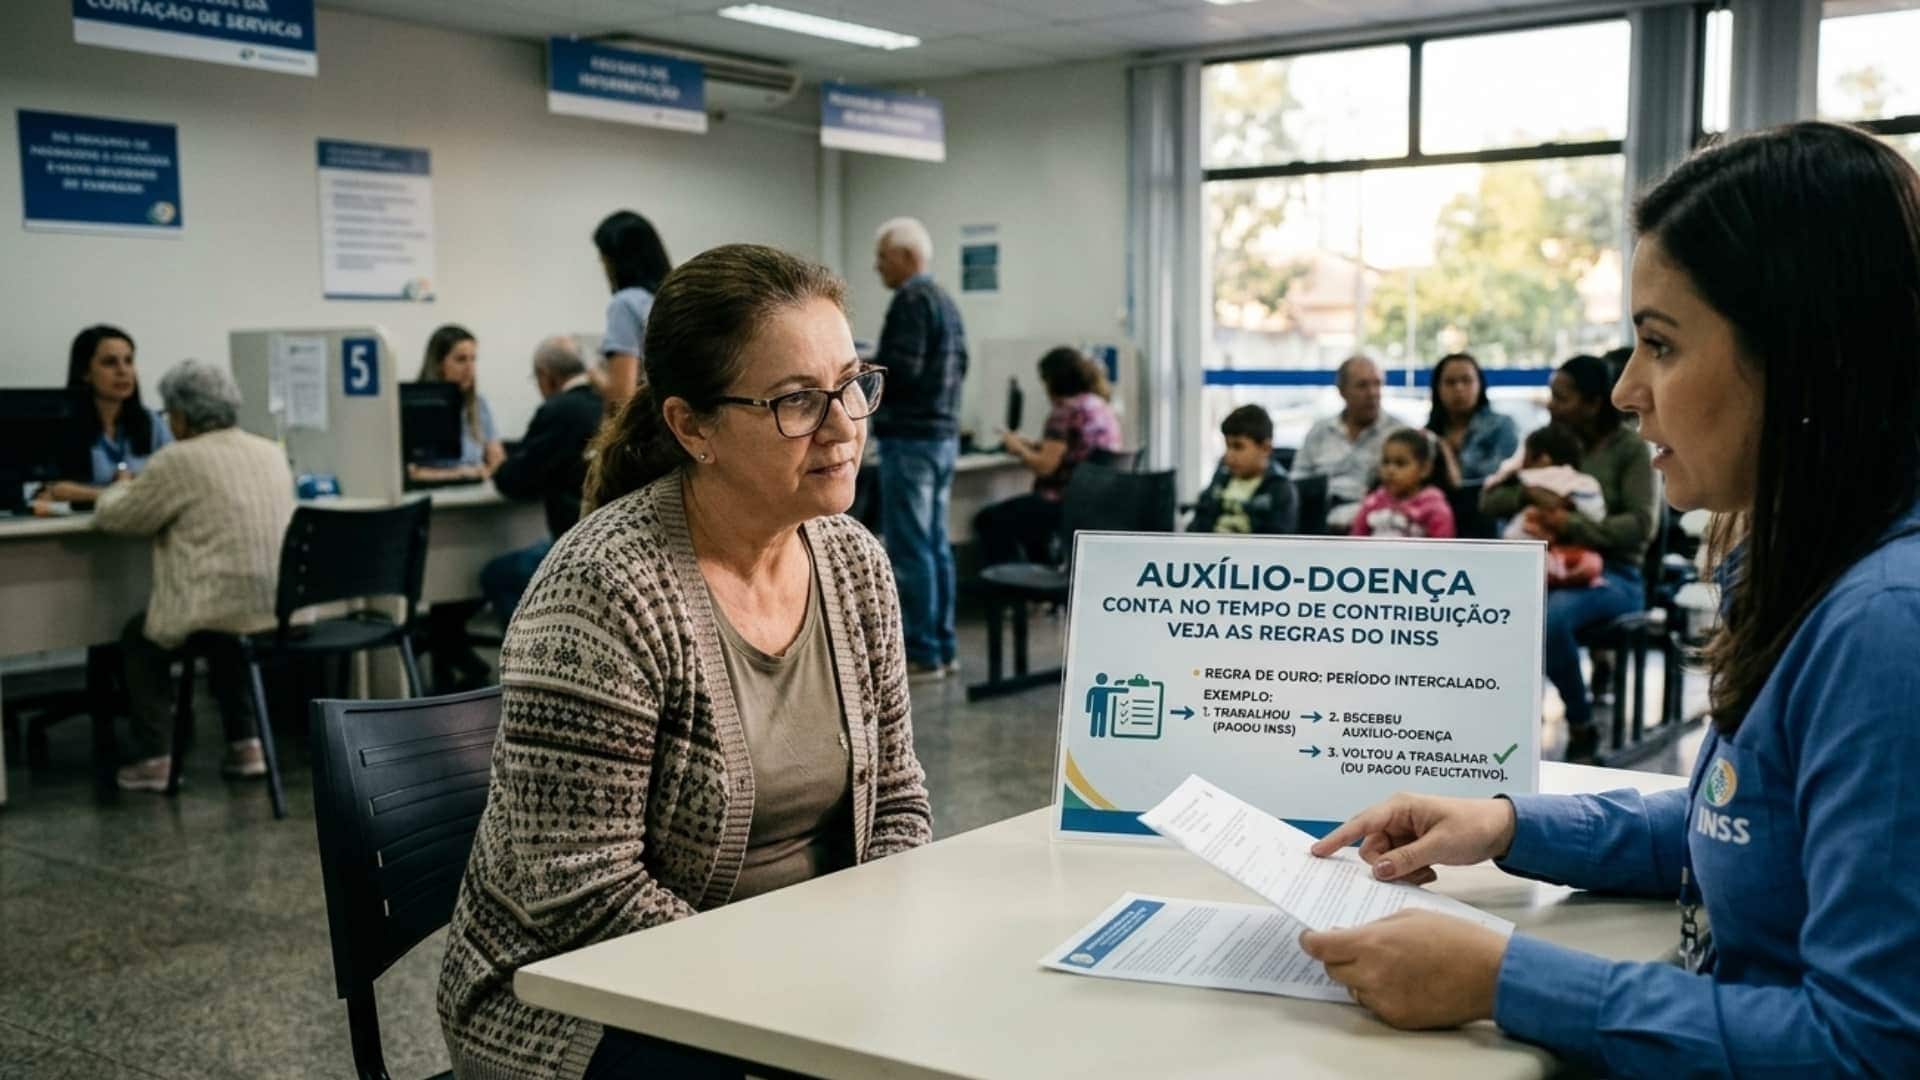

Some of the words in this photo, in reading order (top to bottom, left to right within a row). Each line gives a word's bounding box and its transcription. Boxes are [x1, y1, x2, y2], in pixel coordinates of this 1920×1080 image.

[351, 345, 370, 389] 5
[1135, 556, 1477, 602] AUXÍLIO-DOENÇA
[1102, 597, 1174, 613] CONTA
[1179, 599, 1211, 615] NO
[1216, 600, 1291, 617] TEMPO
[1297, 603, 1327, 618] DE
[1167, 622, 1220, 638] VEJA
[1224, 624, 1253, 639] AS
[1259, 625, 1345, 643] REGRAS
[1351, 628, 1384, 644] DO
[1390, 629, 1439, 646] INSS
[1204, 668, 1252, 680] REGRA
[1255, 670, 1274, 680] DE
[1277, 671, 1323, 682] OURO:
[1326, 671, 1391, 685] PERÍODO
[1394, 675, 1500, 690] INTERCALADO.
[1203, 689, 1273, 702] EXEMPLO:
[1328, 712, 1340, 722] 2.
[1263, 724, 1296, 736] INSS)
[1327, 747, 1339, 757] 3.
[1341, 748, 1394, 759] VOLTOU
[1396, 751, 1407, 760] A
[1367, 764, 1411, 775] PAGOU
[1697, 807, 1751, 845] INSS
